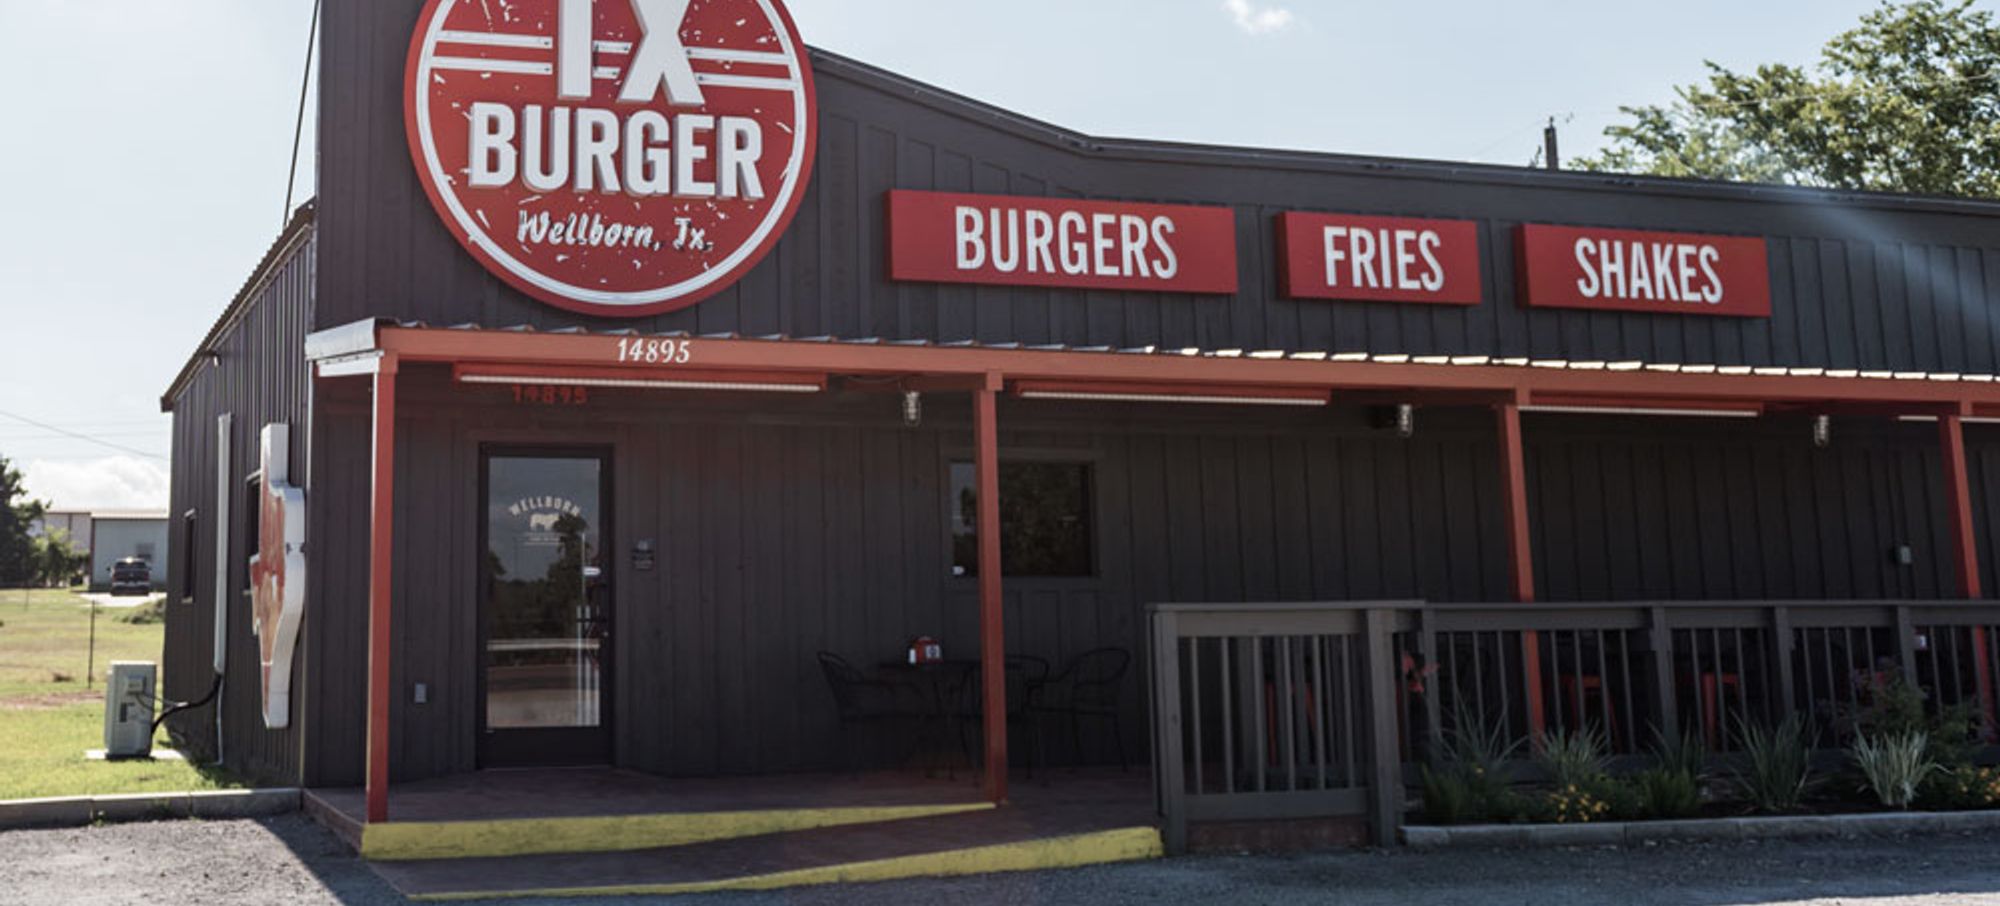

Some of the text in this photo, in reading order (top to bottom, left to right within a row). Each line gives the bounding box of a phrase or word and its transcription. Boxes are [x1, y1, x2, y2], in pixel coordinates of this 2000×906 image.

[469, 102, 765, 199] BURGER
[517, 210, 661, 251] Wellborn,
[955, 206, 1178, 280] BURGERS
[1323, 226, 1445, 292] FRIES
[1574, 238, 1723, 303] SHAKES
[617, 337, 690, 363] 14895
[508, 495, 581, 517] WELLBORN
